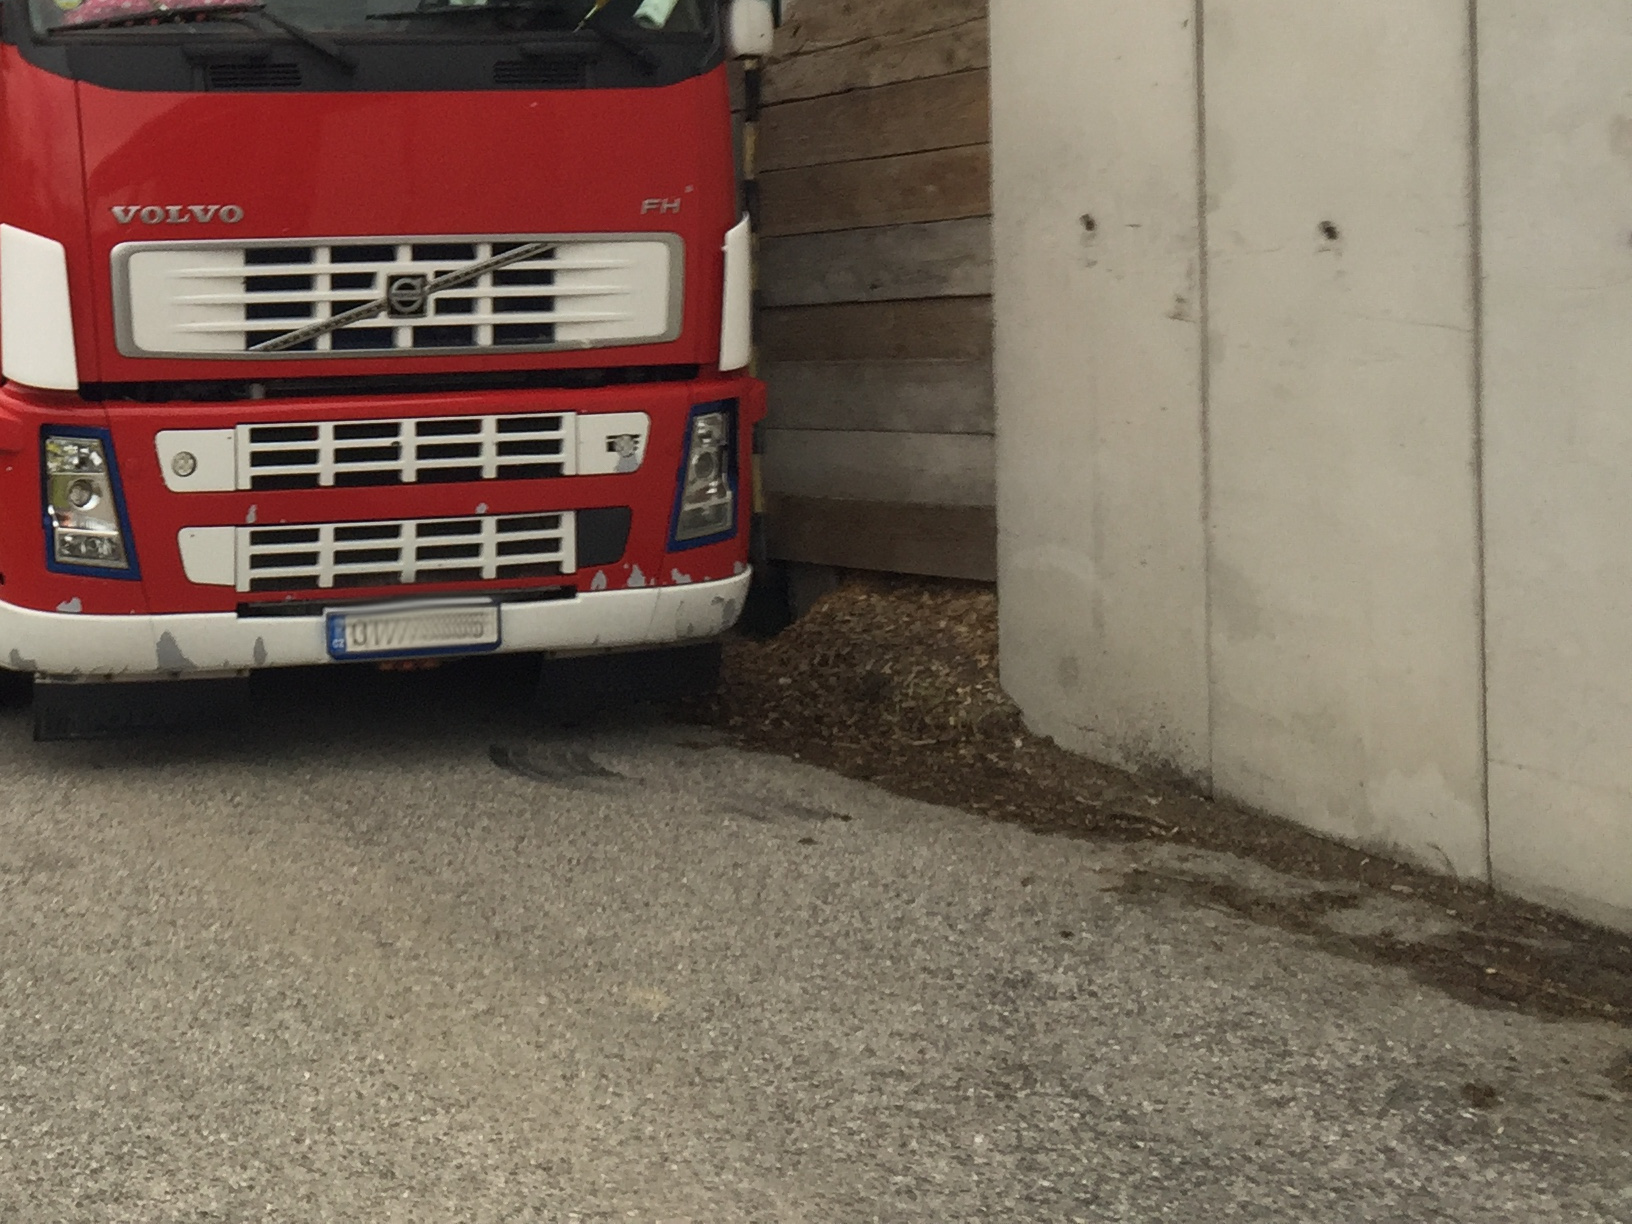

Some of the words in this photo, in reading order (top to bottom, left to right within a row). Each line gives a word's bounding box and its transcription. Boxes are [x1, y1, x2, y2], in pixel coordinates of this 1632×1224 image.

[111, 204, 245, 225] VOLVO
[640, 197, 682, 215] FH
[332, 638, 345, 649] CZ
